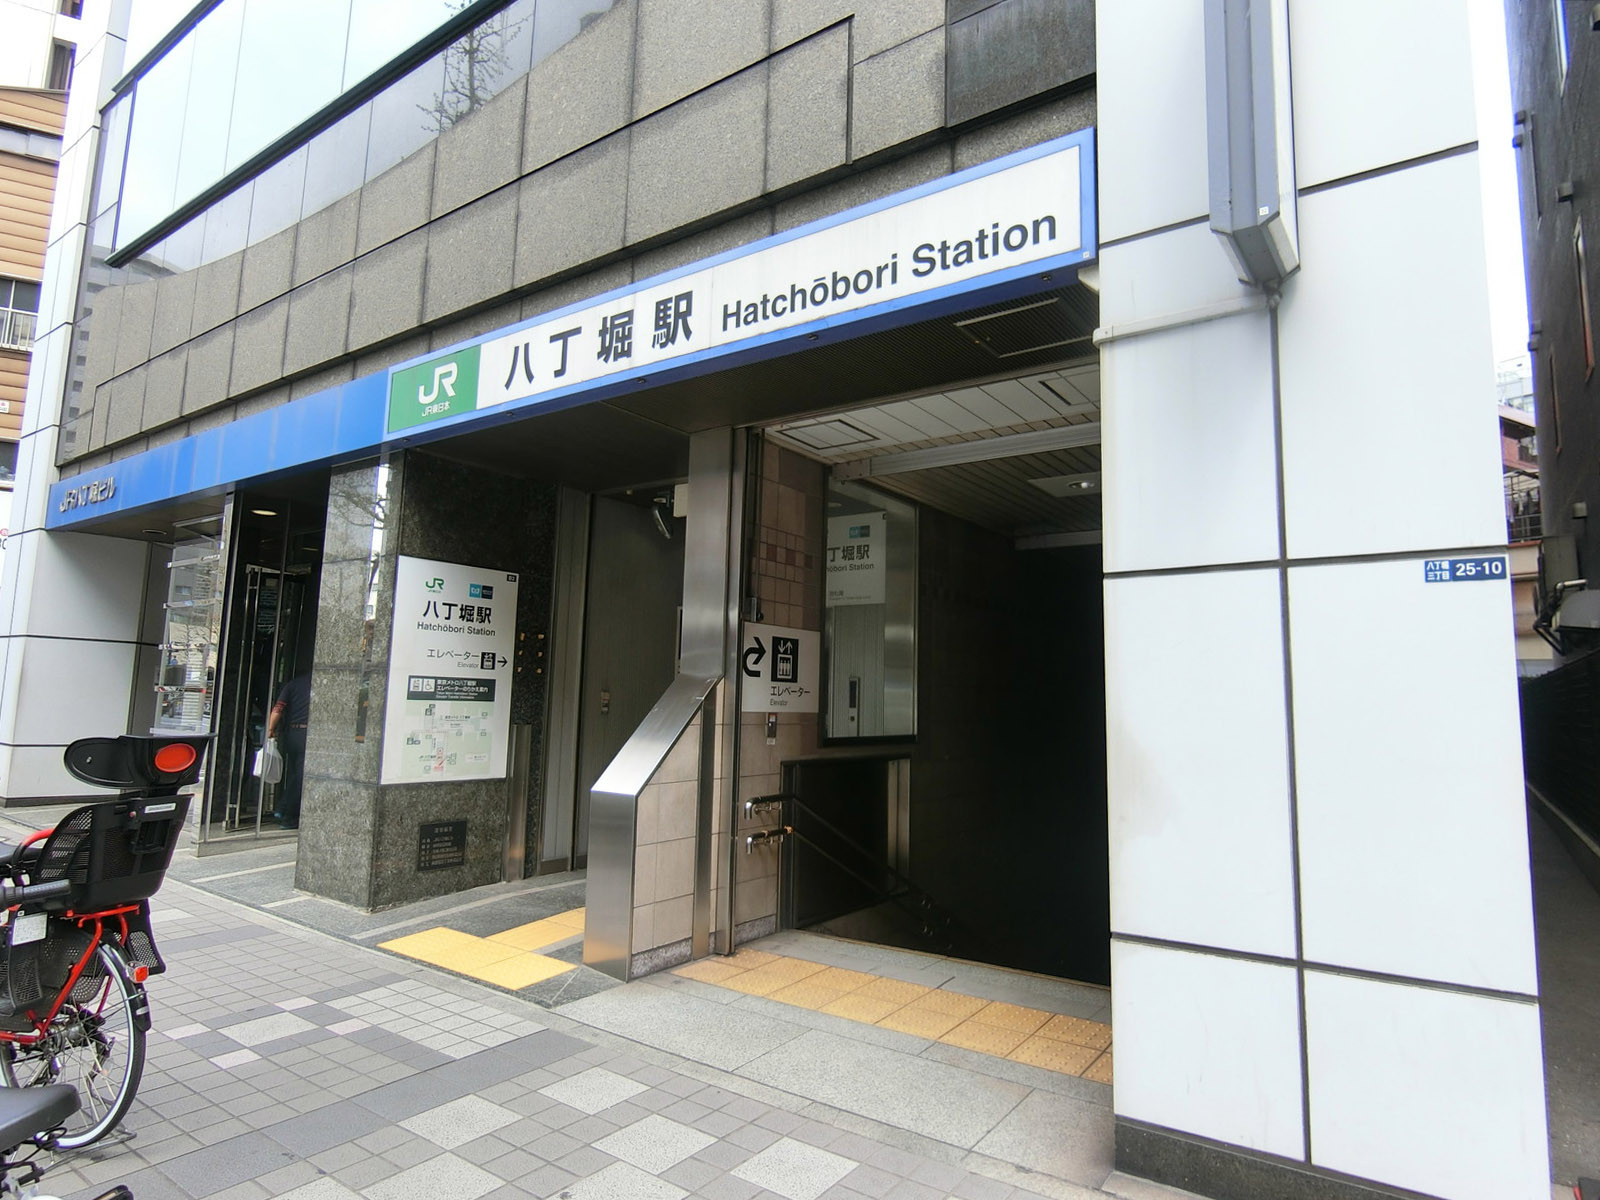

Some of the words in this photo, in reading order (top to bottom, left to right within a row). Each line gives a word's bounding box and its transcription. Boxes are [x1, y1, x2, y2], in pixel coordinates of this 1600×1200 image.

[505, 291, 693, 390] 八丁堀駅
[721, 253, 898, 331] Hatchōbori
[912, 214, 1057, 277] Station
[418, 362, 458, 404] JR
[421, 401, 451, 417] JR東日本
[849, 562, 875, 572] Station
[1455, 561, 1502, 577] 25-10
[1426, 571, 1450, 581] 三丁目
[425, 577, 445, 590] JR
[423, 600, 492, 625] 八丁堀駅
[467, 625, 496, 637] Station
[426, 648, 480, 660] エレベーター
[457, 661, 479, 669] Elevator
[770, 685, 811, 697] エレベーター
